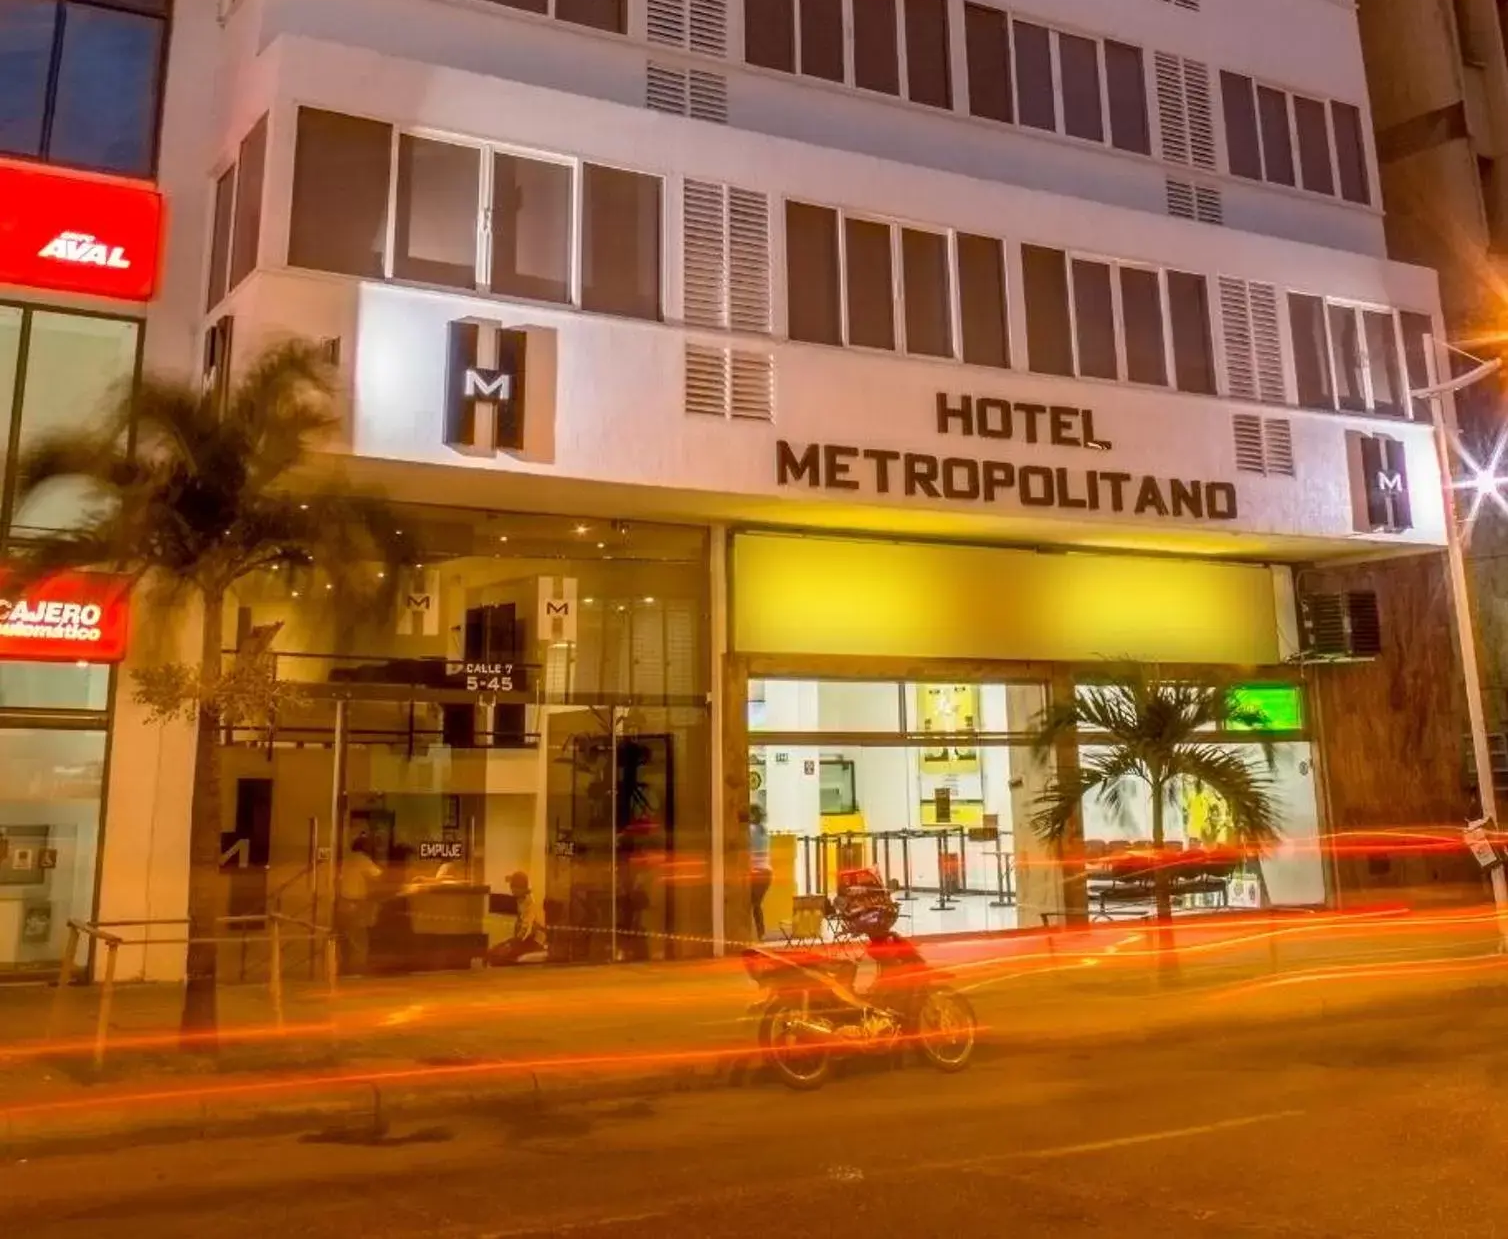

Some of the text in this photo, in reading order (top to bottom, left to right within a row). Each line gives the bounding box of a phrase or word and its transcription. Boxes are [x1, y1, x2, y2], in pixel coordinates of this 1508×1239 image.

[38, 237, 130, 269] AVAL
[464, 368, 510, 400] M
[935, 392, 1113, 451] HOTEL
[775, 439, 1238, 520] METROPOLITANO
[1376, 471, 1403, 494] M
[406, 595, 430, 610] M
[546, 601, 569, 616] M
[466, 663, 513, 675] CALLE 7
[466, 676, 513, 692] 5-45
[420, 843, 462, 858] EMPUJE
